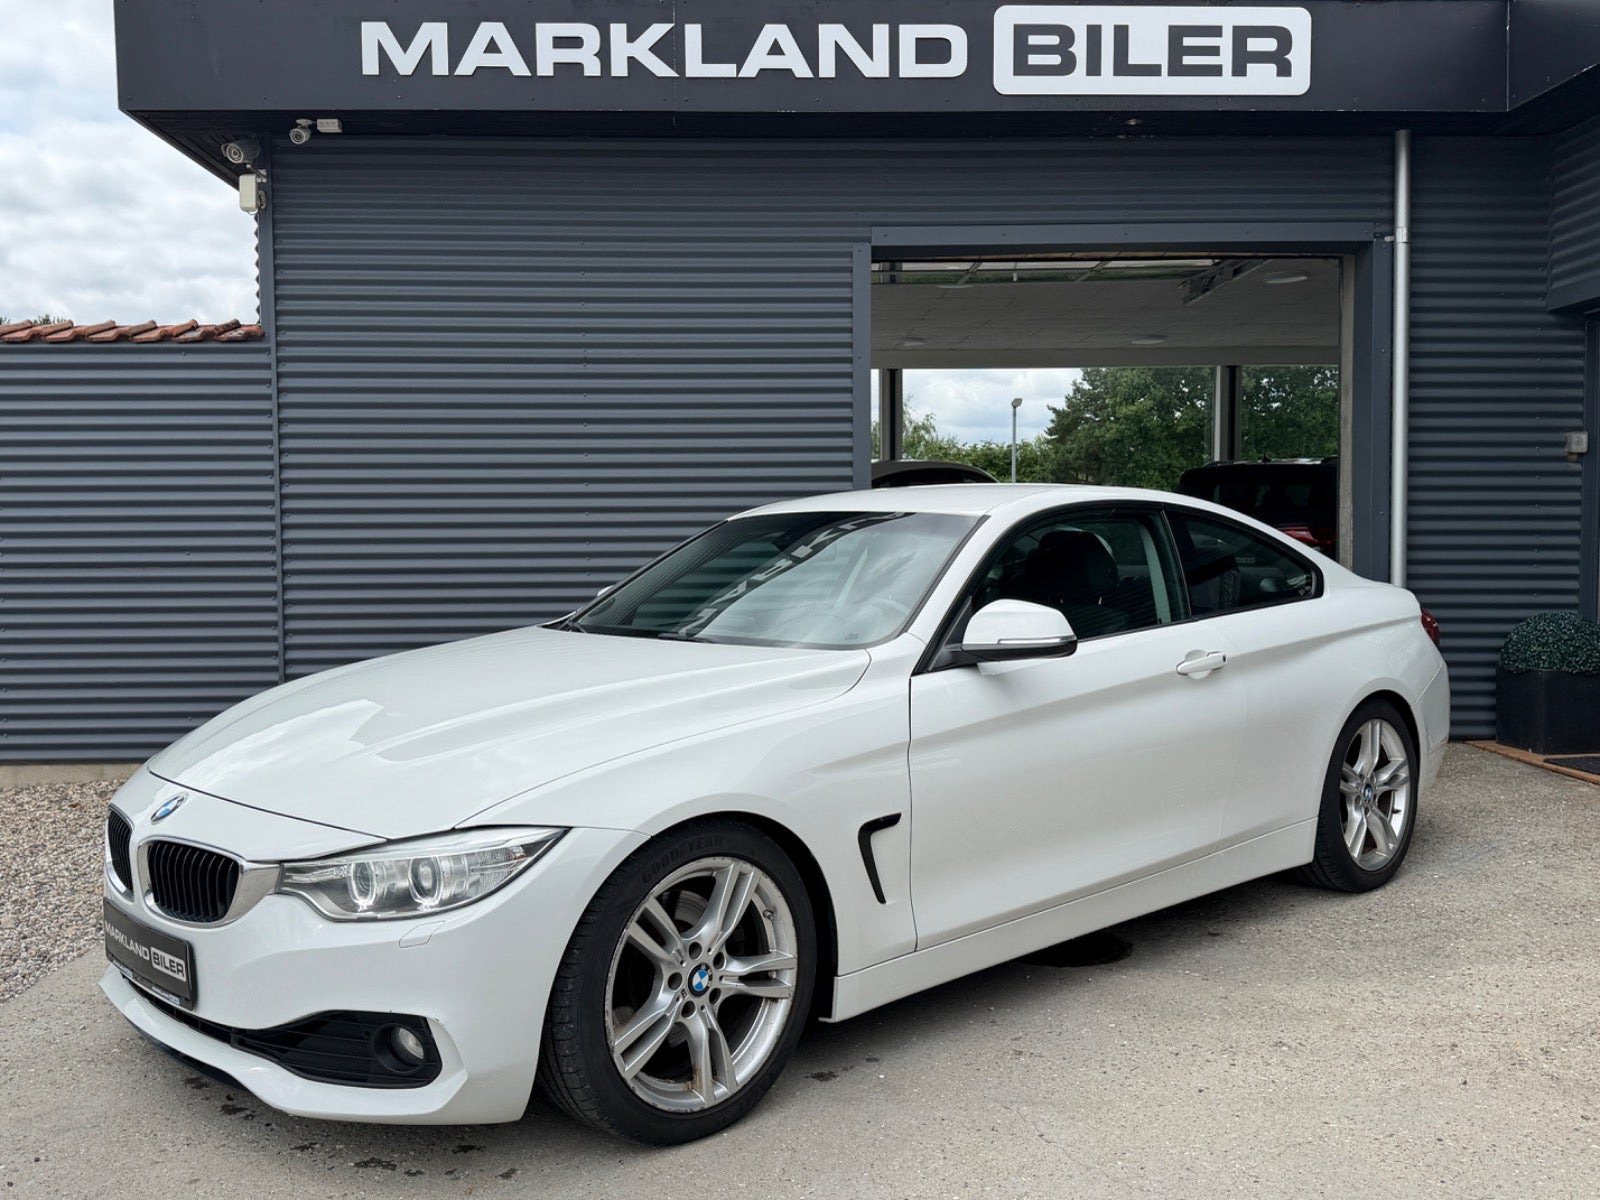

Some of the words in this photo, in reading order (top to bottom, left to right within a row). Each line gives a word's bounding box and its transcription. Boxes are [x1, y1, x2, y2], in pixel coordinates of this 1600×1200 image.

[361, 21, 968, 78] MARKLAND
[1012, 23, 1292, 77] BILER
[104, 920, 150, 961] MARKLAND
[152, 952, 185, 978] BILER
